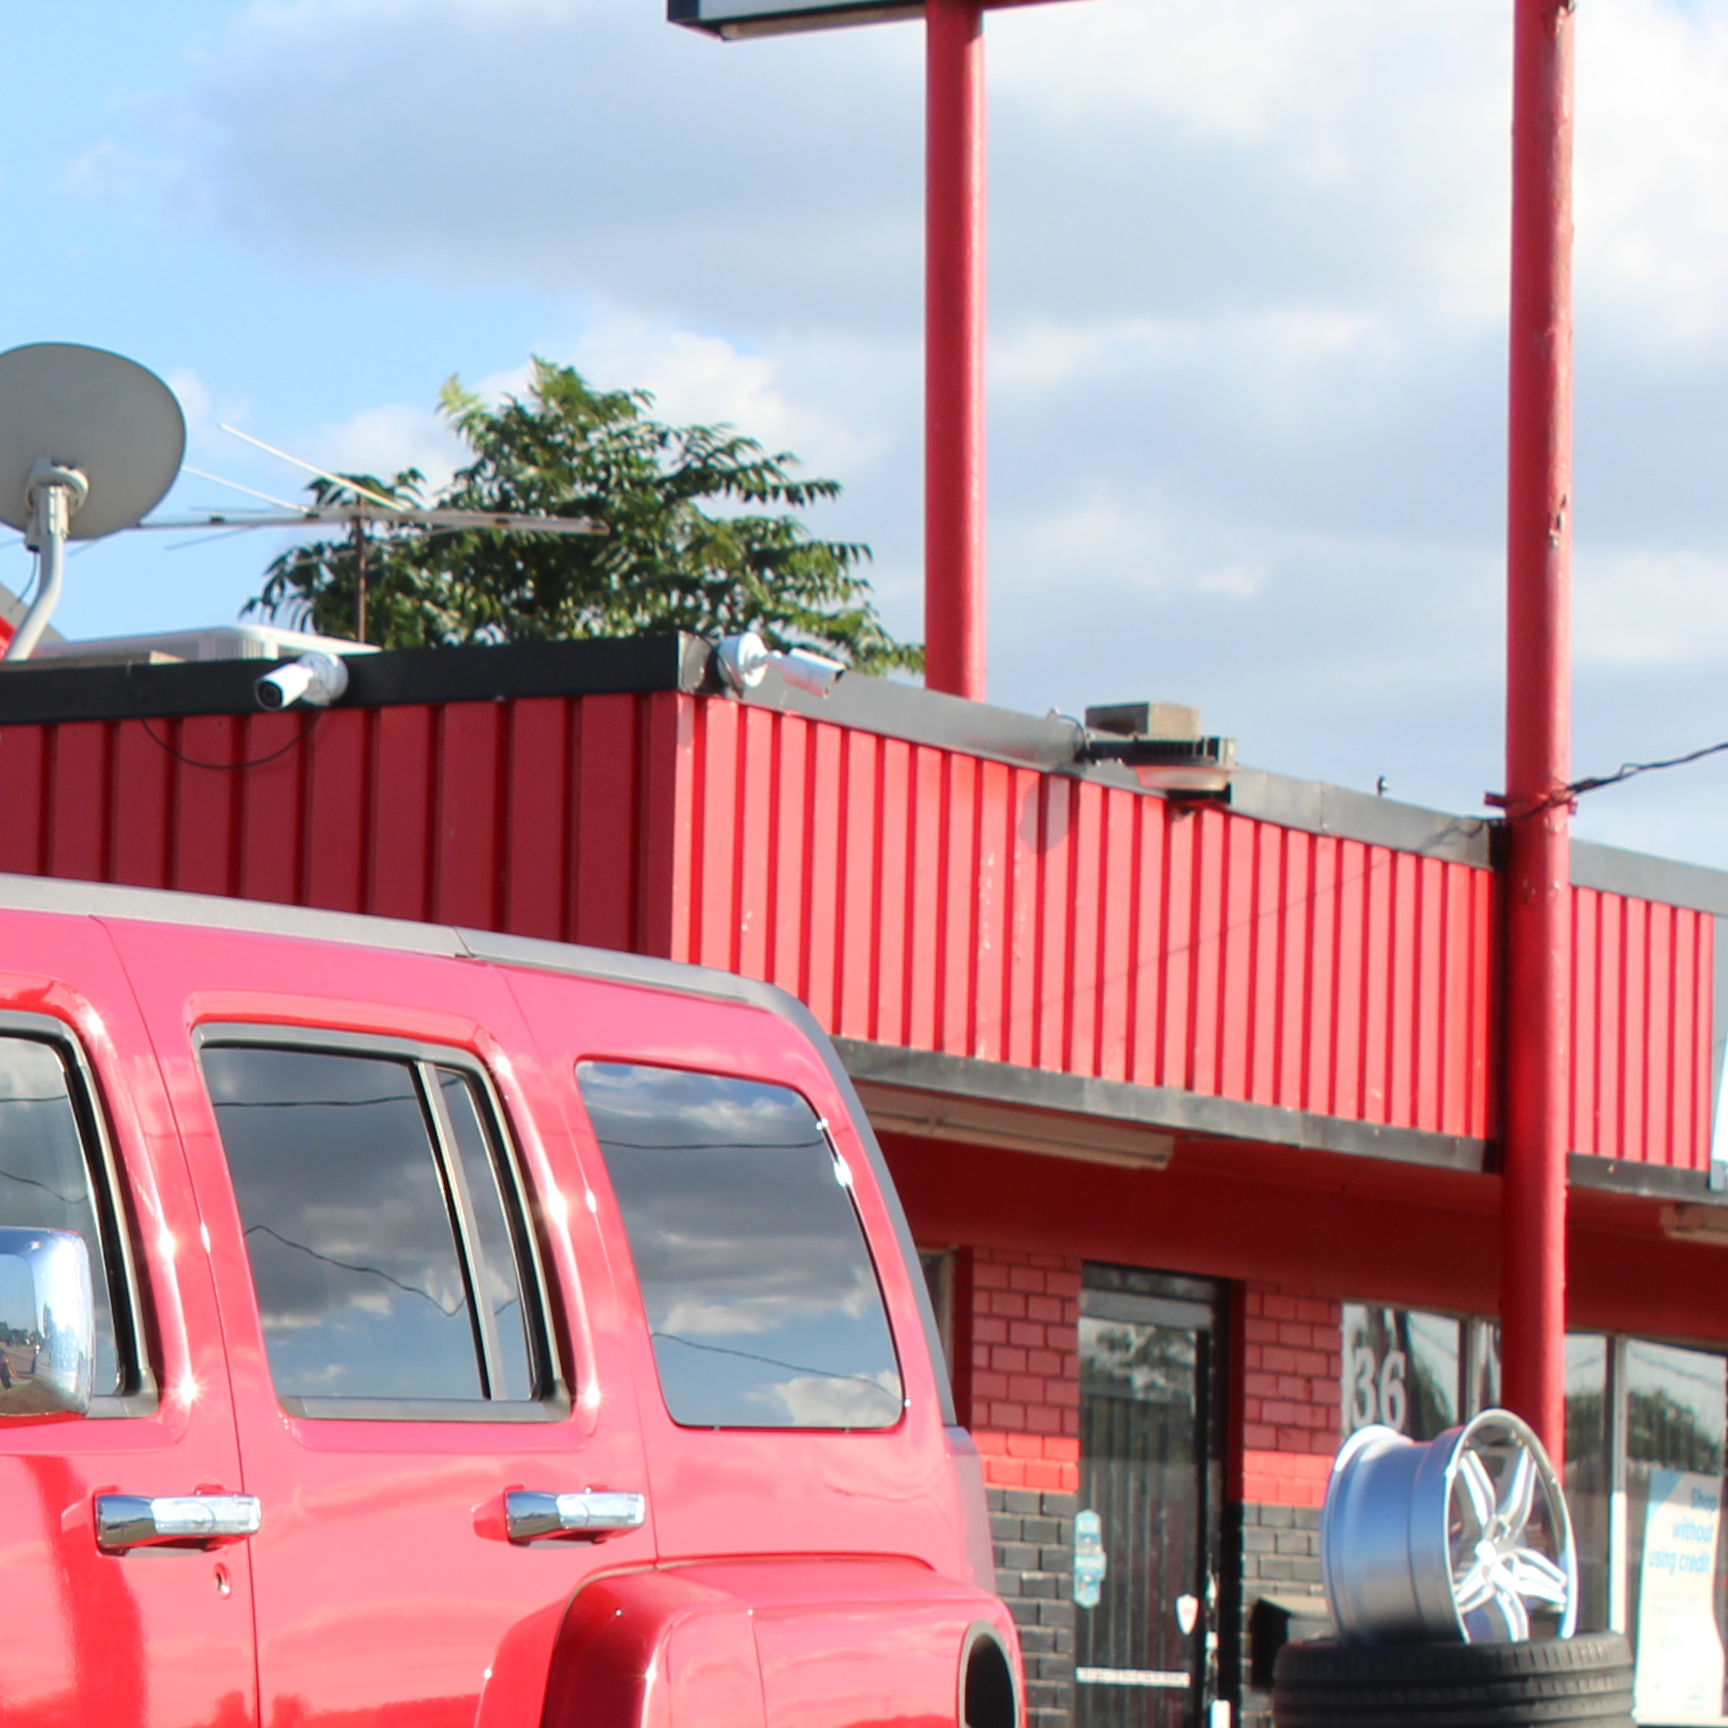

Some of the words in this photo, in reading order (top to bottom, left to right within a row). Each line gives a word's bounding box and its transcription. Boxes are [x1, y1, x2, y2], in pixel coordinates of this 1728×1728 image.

[1672, 1517, 1714, 1543] without
[1649, 1546, 1677, 1574] using
[1678, 1549, 1710, 1573] credit
